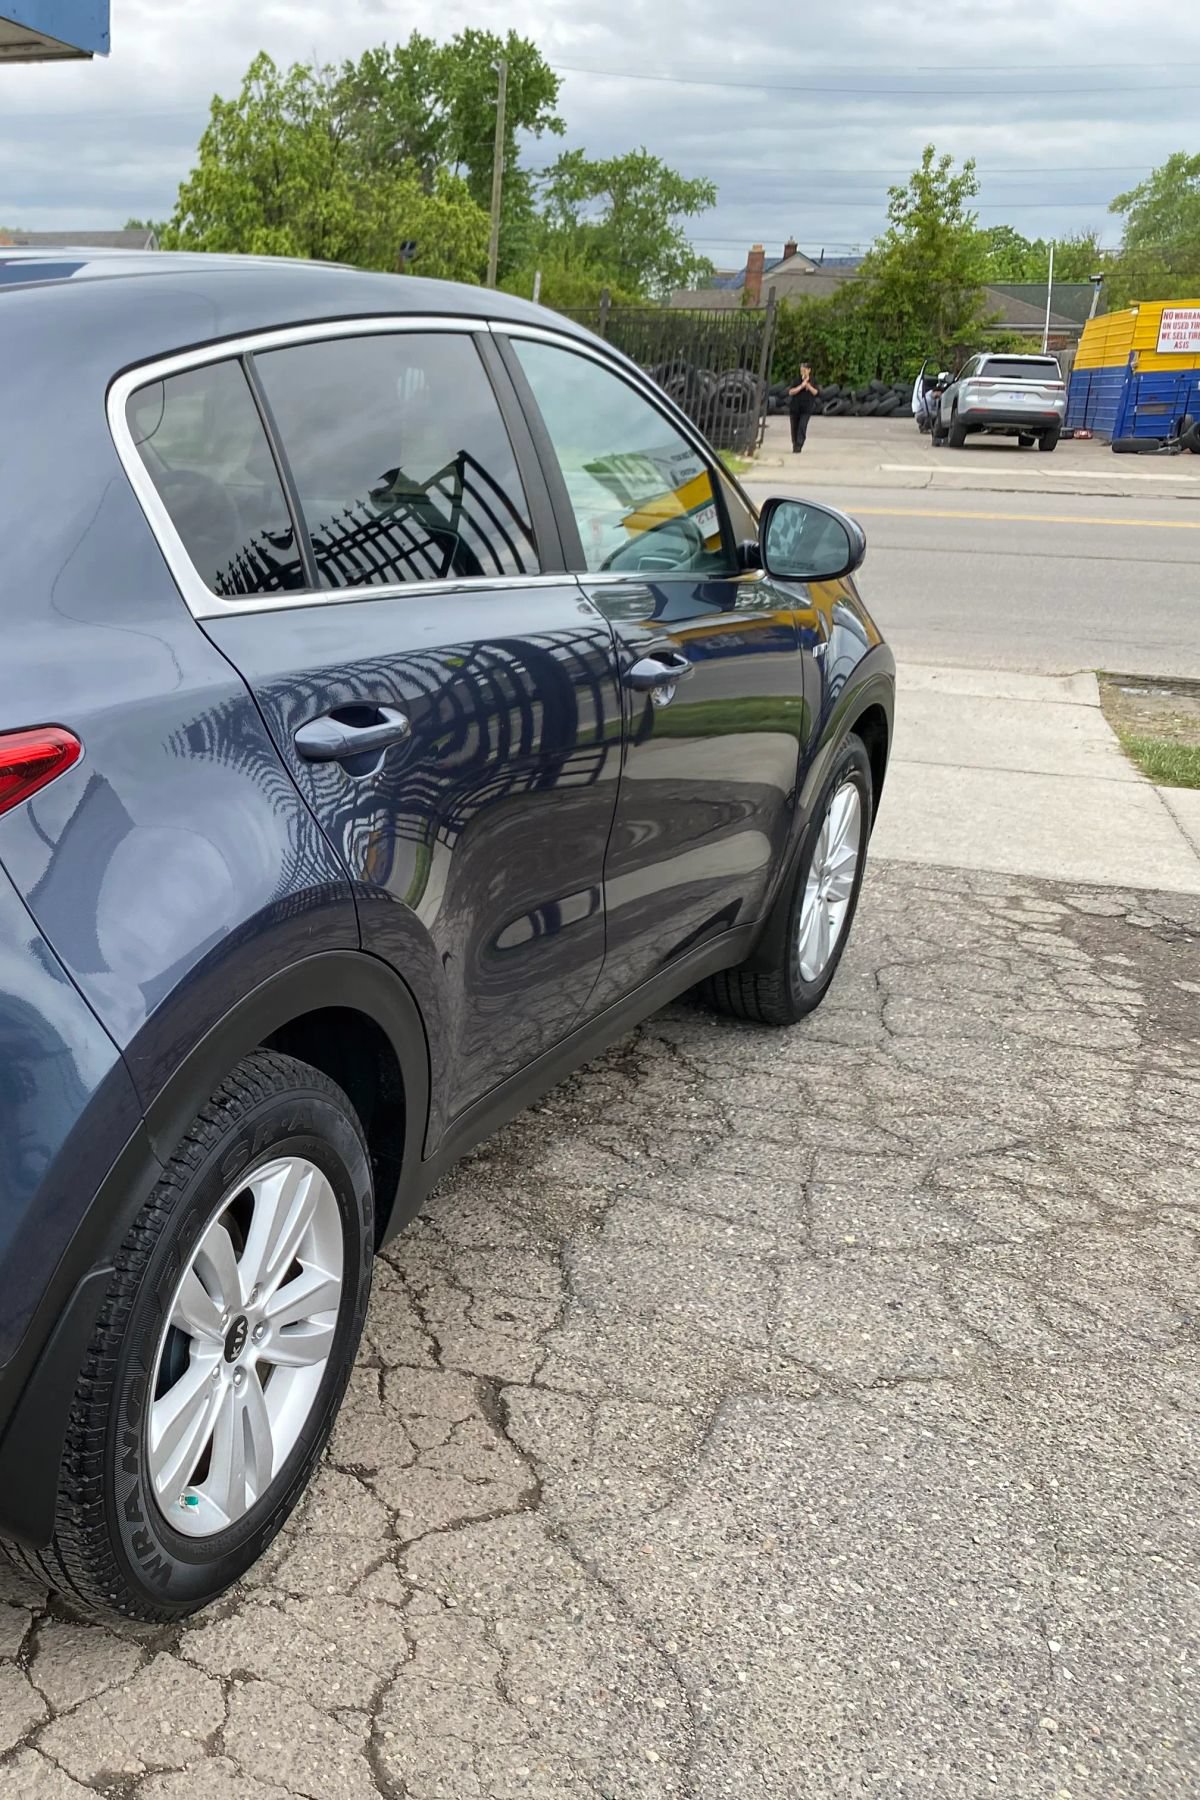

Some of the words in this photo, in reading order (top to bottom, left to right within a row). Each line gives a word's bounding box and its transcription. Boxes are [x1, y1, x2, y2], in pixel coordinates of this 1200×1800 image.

[1163, 312, 1174, 320] NO
[1162, 322, 1172, 330] ON
[1173, 322, 1189, 330] USED
[1161, 332, 1171, 340] WE
[1173, 332, 1186, 340] SELL
[230, 1320, 246, 1359] KIA
